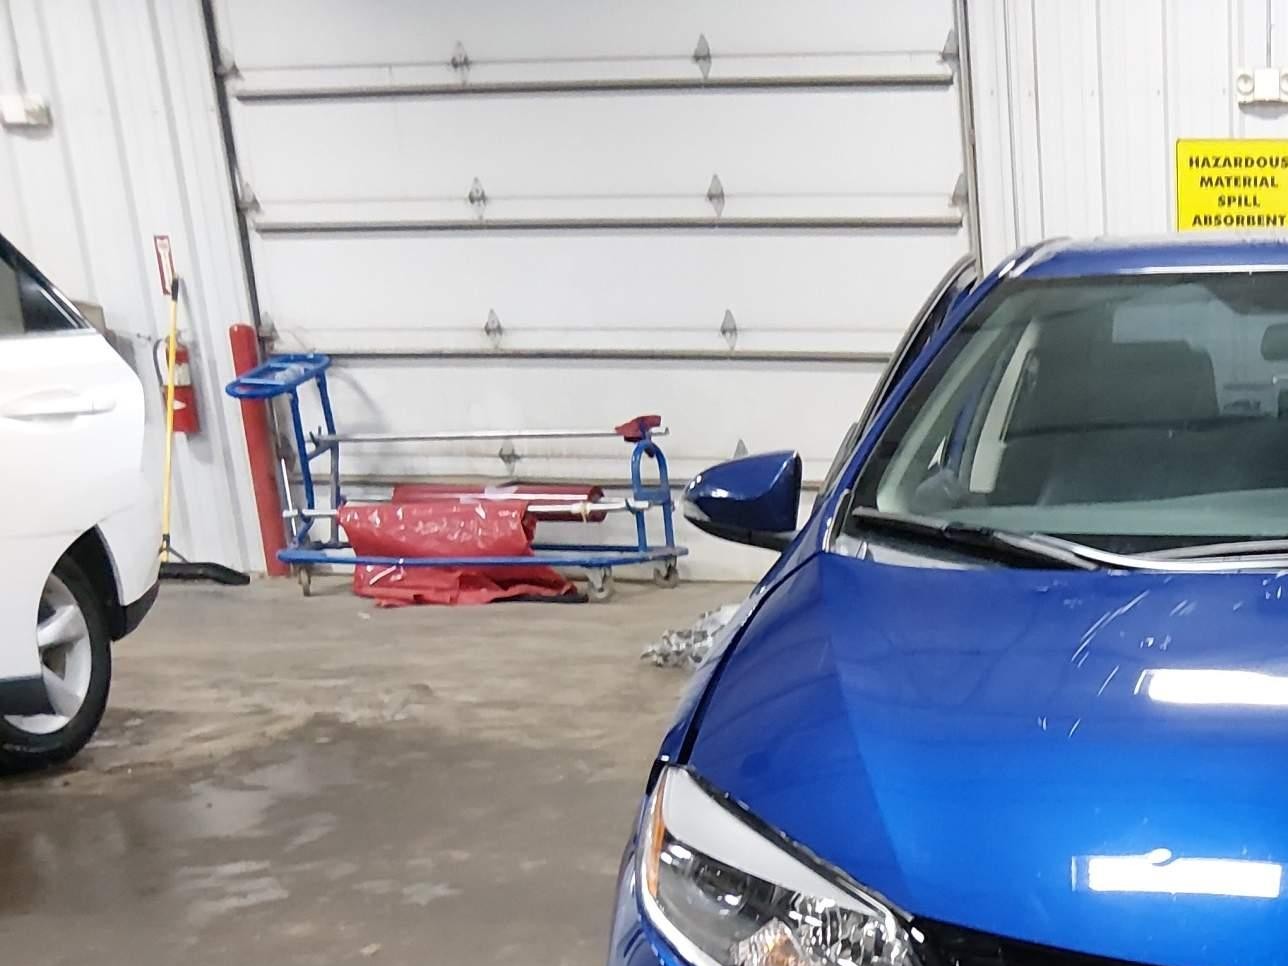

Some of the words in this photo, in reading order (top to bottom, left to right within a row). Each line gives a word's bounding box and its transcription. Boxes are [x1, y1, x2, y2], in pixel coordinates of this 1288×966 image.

[1199, 175, 1279, 188] MATERIAL
[1217, 194, 1261, 208] SPILL
[1191, 214, 1287, 227] ABSORBENT
